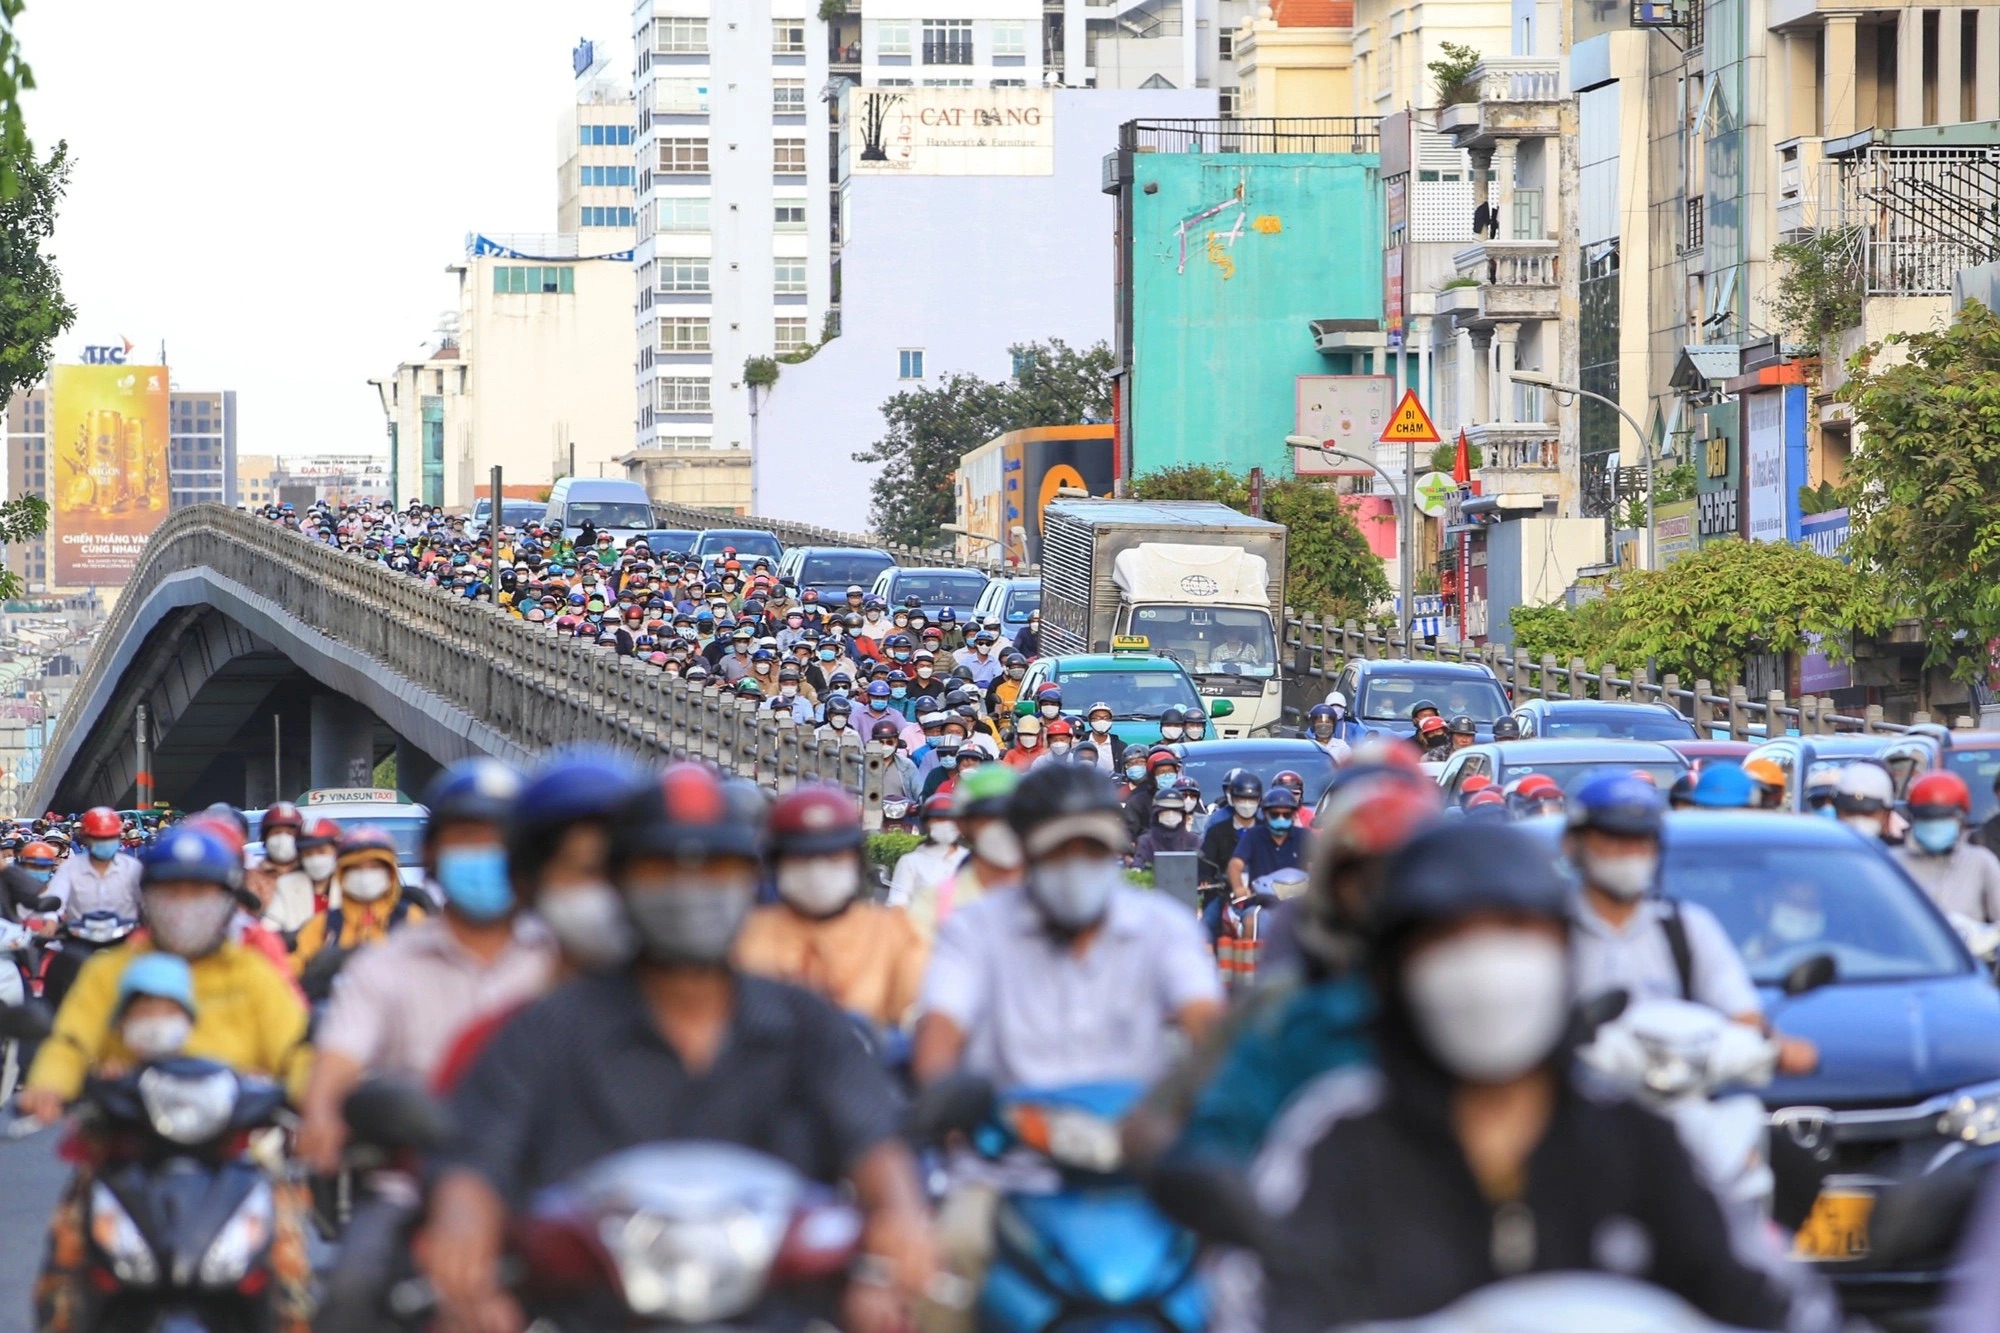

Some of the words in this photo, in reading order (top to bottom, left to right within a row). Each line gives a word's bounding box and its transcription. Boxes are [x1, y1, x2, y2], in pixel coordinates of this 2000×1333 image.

[920, 107, 966, 126] CAT
[977, 137, 986, 147] &
[85, 346, 126, 364] TTC
[1405, 410, 1415, 420] ĐI
[1396, 422, 1424, 436] CHẬM
[112, 544, 140, 554] NHAU
[329, 792, 373, 801] VINASUN
[373, 792, 392, 800] TAXI
